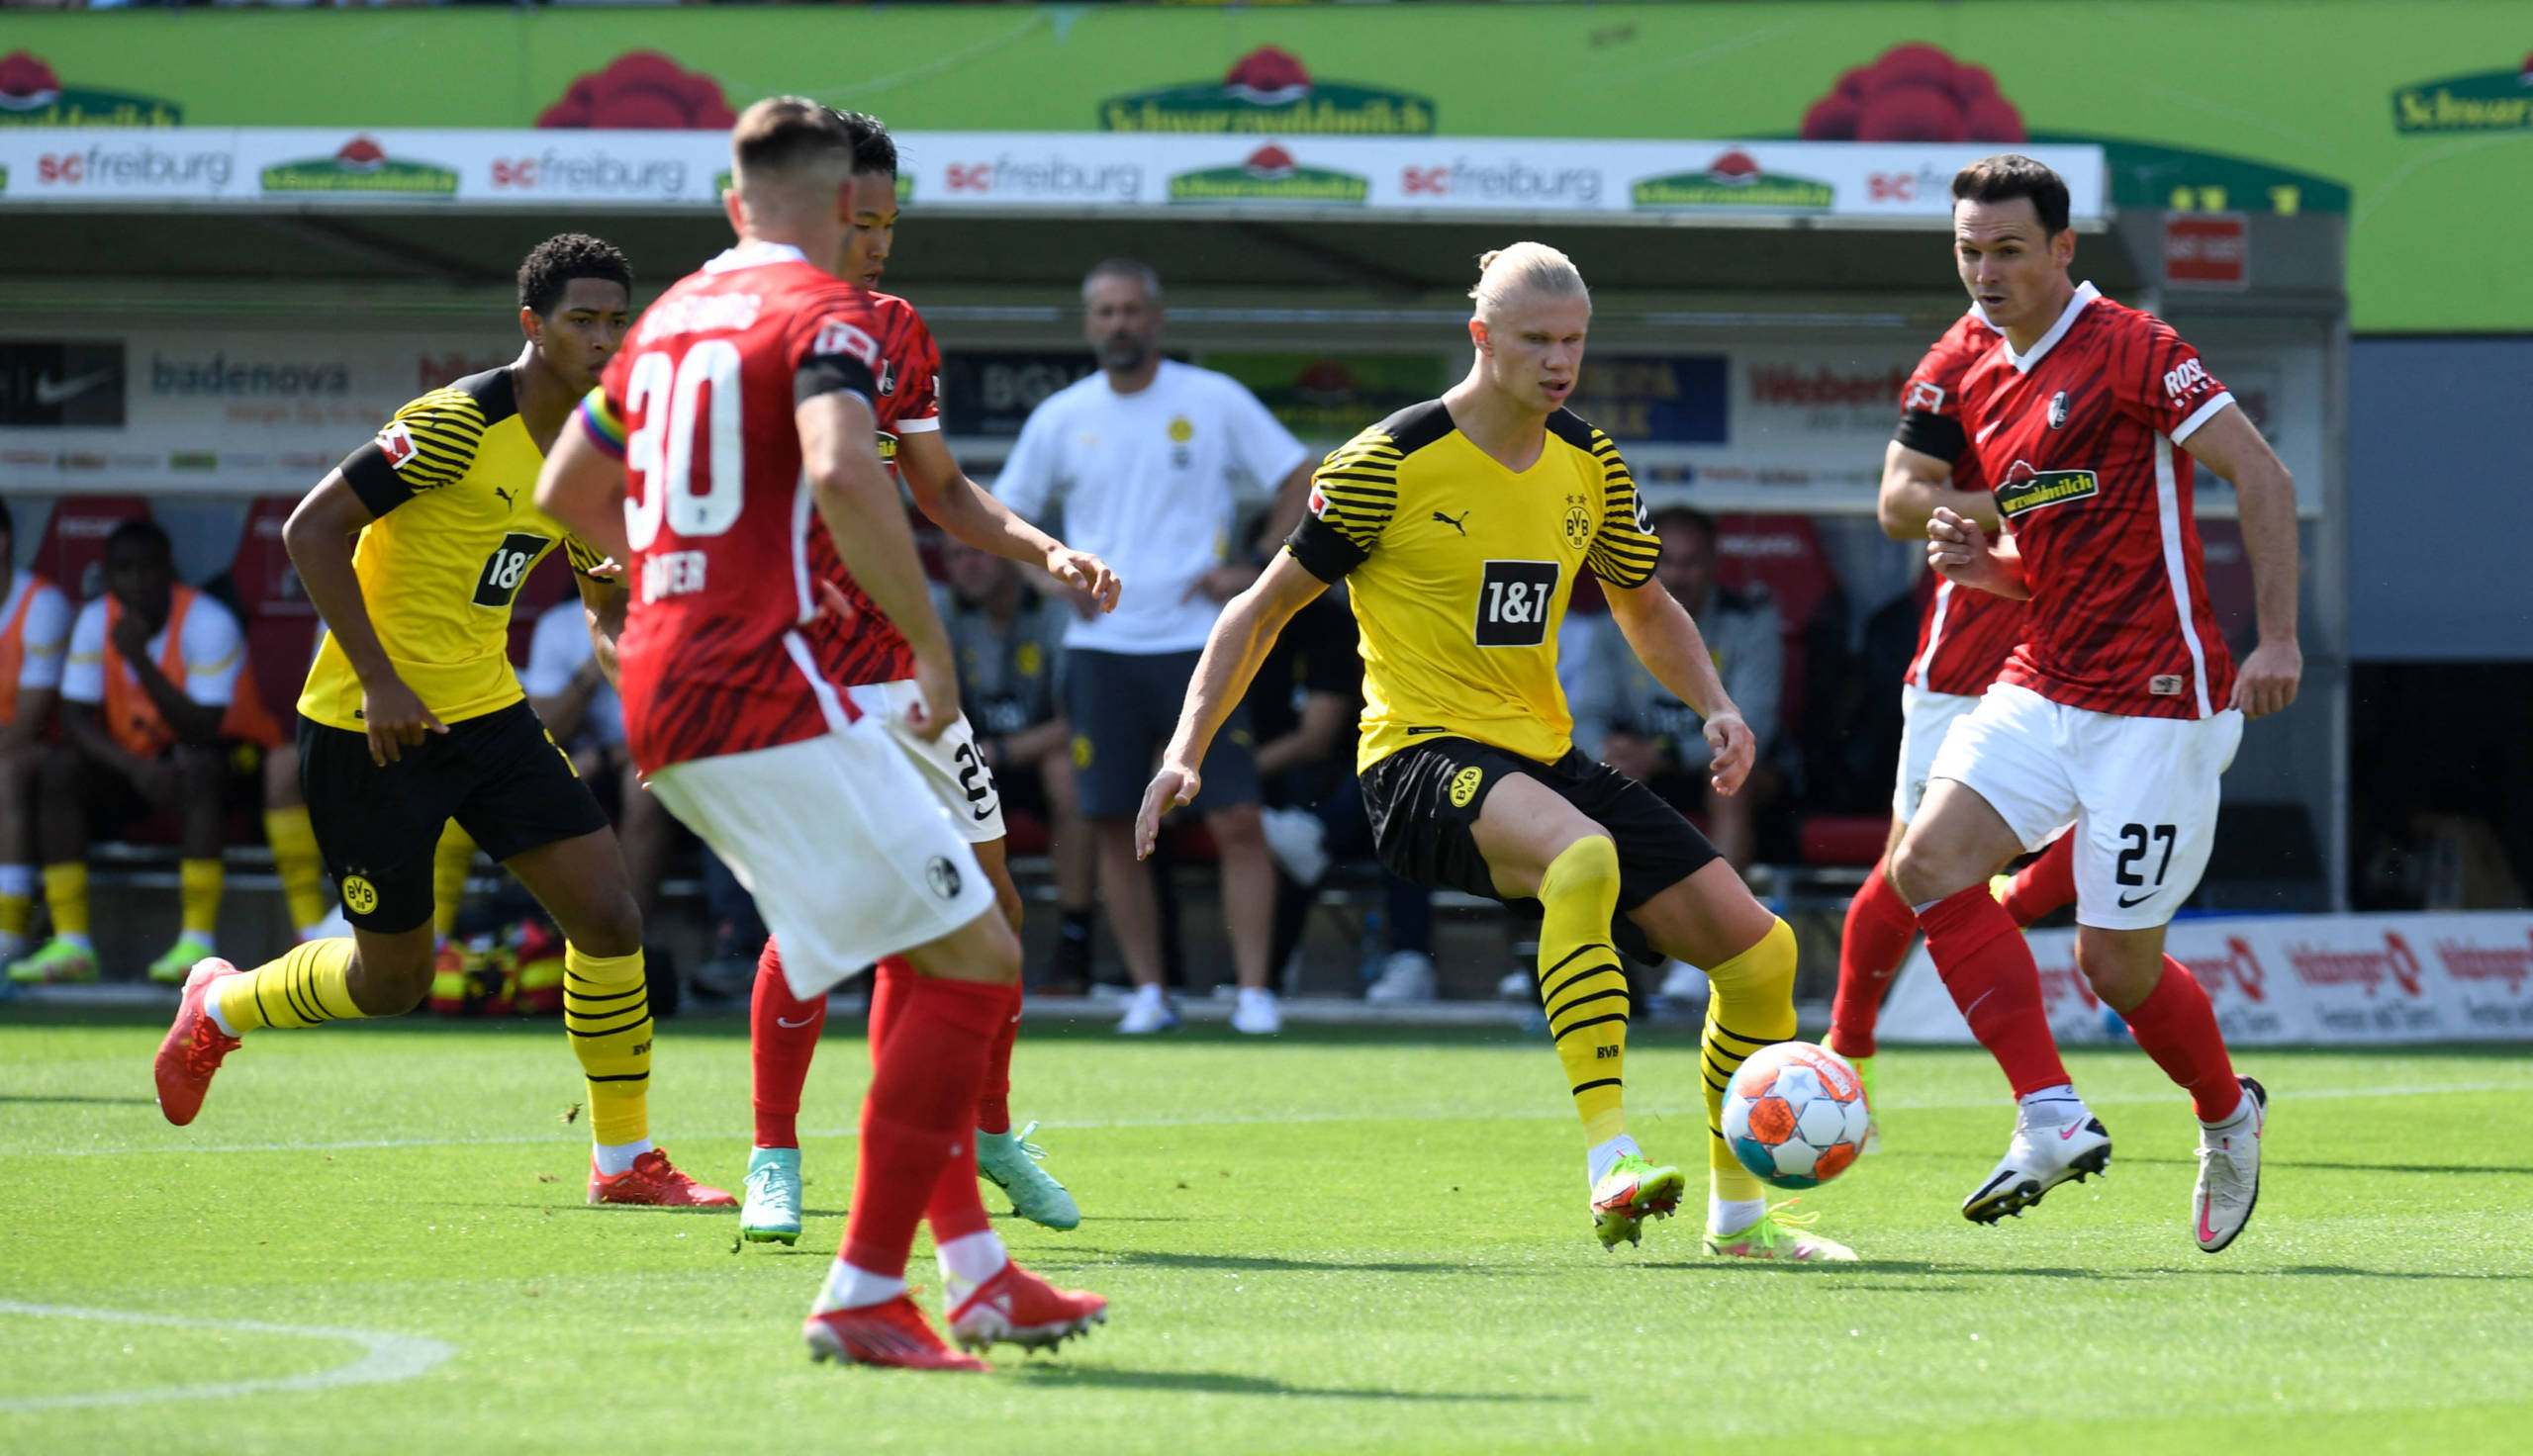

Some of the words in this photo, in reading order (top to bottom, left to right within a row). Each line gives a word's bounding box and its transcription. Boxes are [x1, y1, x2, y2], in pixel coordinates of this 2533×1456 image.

[623, 338, 744, 552] 30
[1566, 509, 1589, 537] BVB
[1488, 581, 1550, 623] 1&1
[2115, 823, 2177, 886] 27
[347, 879, 373, 904] BVB
[1596, 1045, 1620, 1059] BVB
